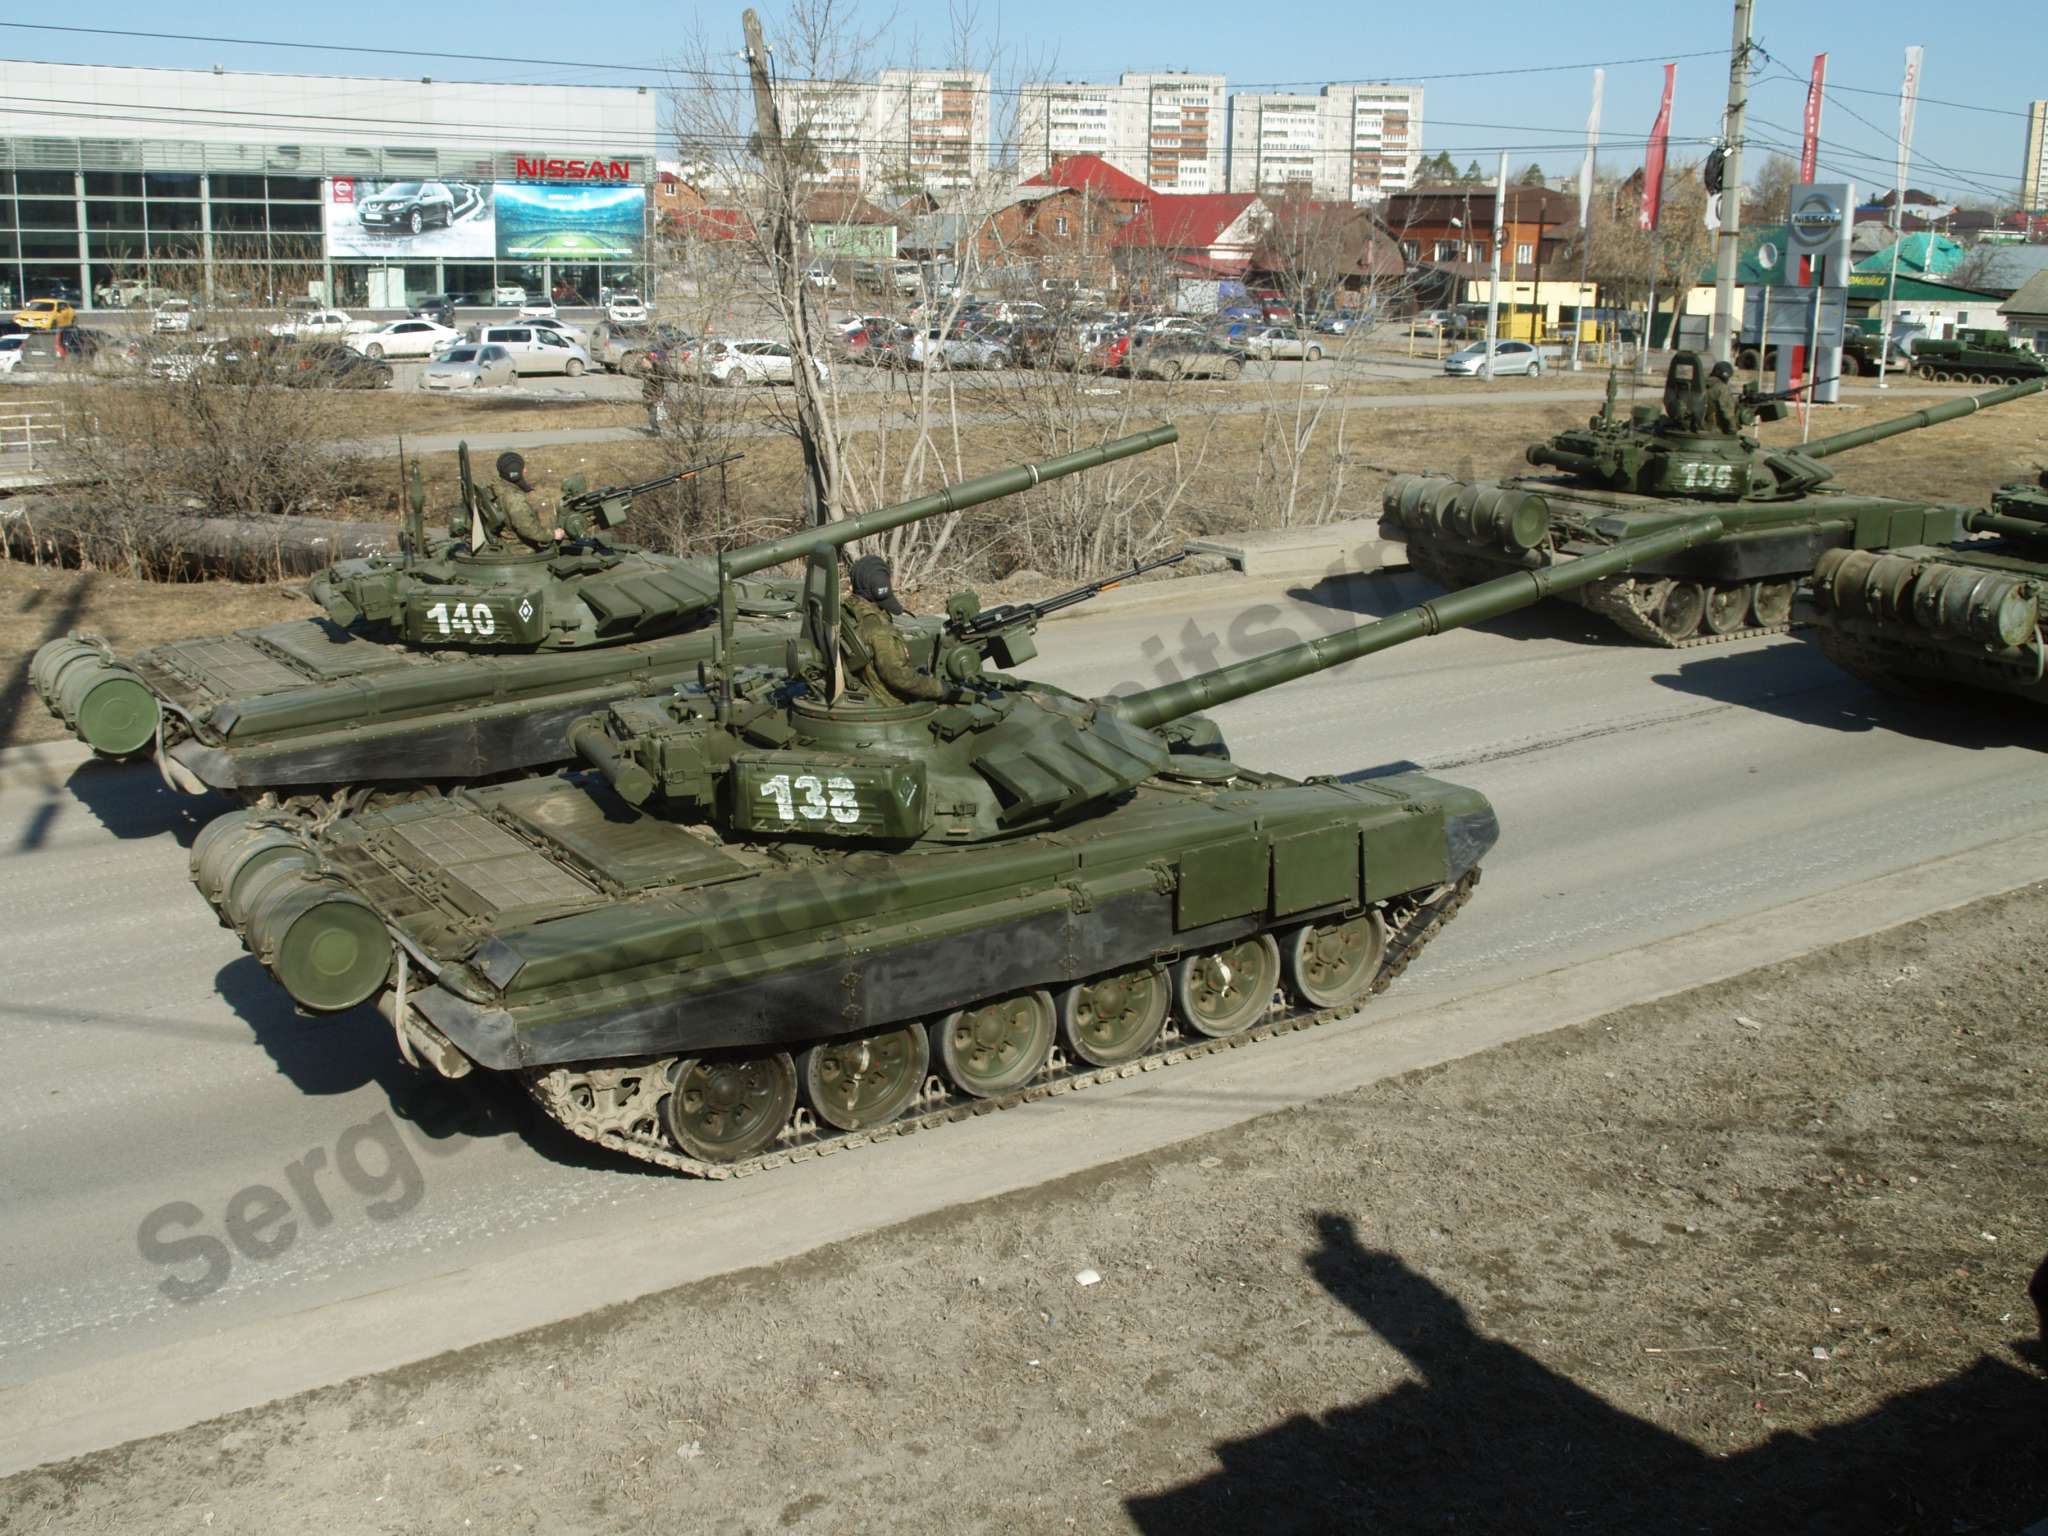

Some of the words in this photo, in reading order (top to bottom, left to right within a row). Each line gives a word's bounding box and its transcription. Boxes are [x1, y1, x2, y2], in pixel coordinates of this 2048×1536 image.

[516, 158, 630, 180] NISSAN
[1794, 214, 1837, 225] NISSAN
[1681, 462, 1733, 489] 136
[426, 602, 495, 635] 140
[760, 774, 860, 824] 138
